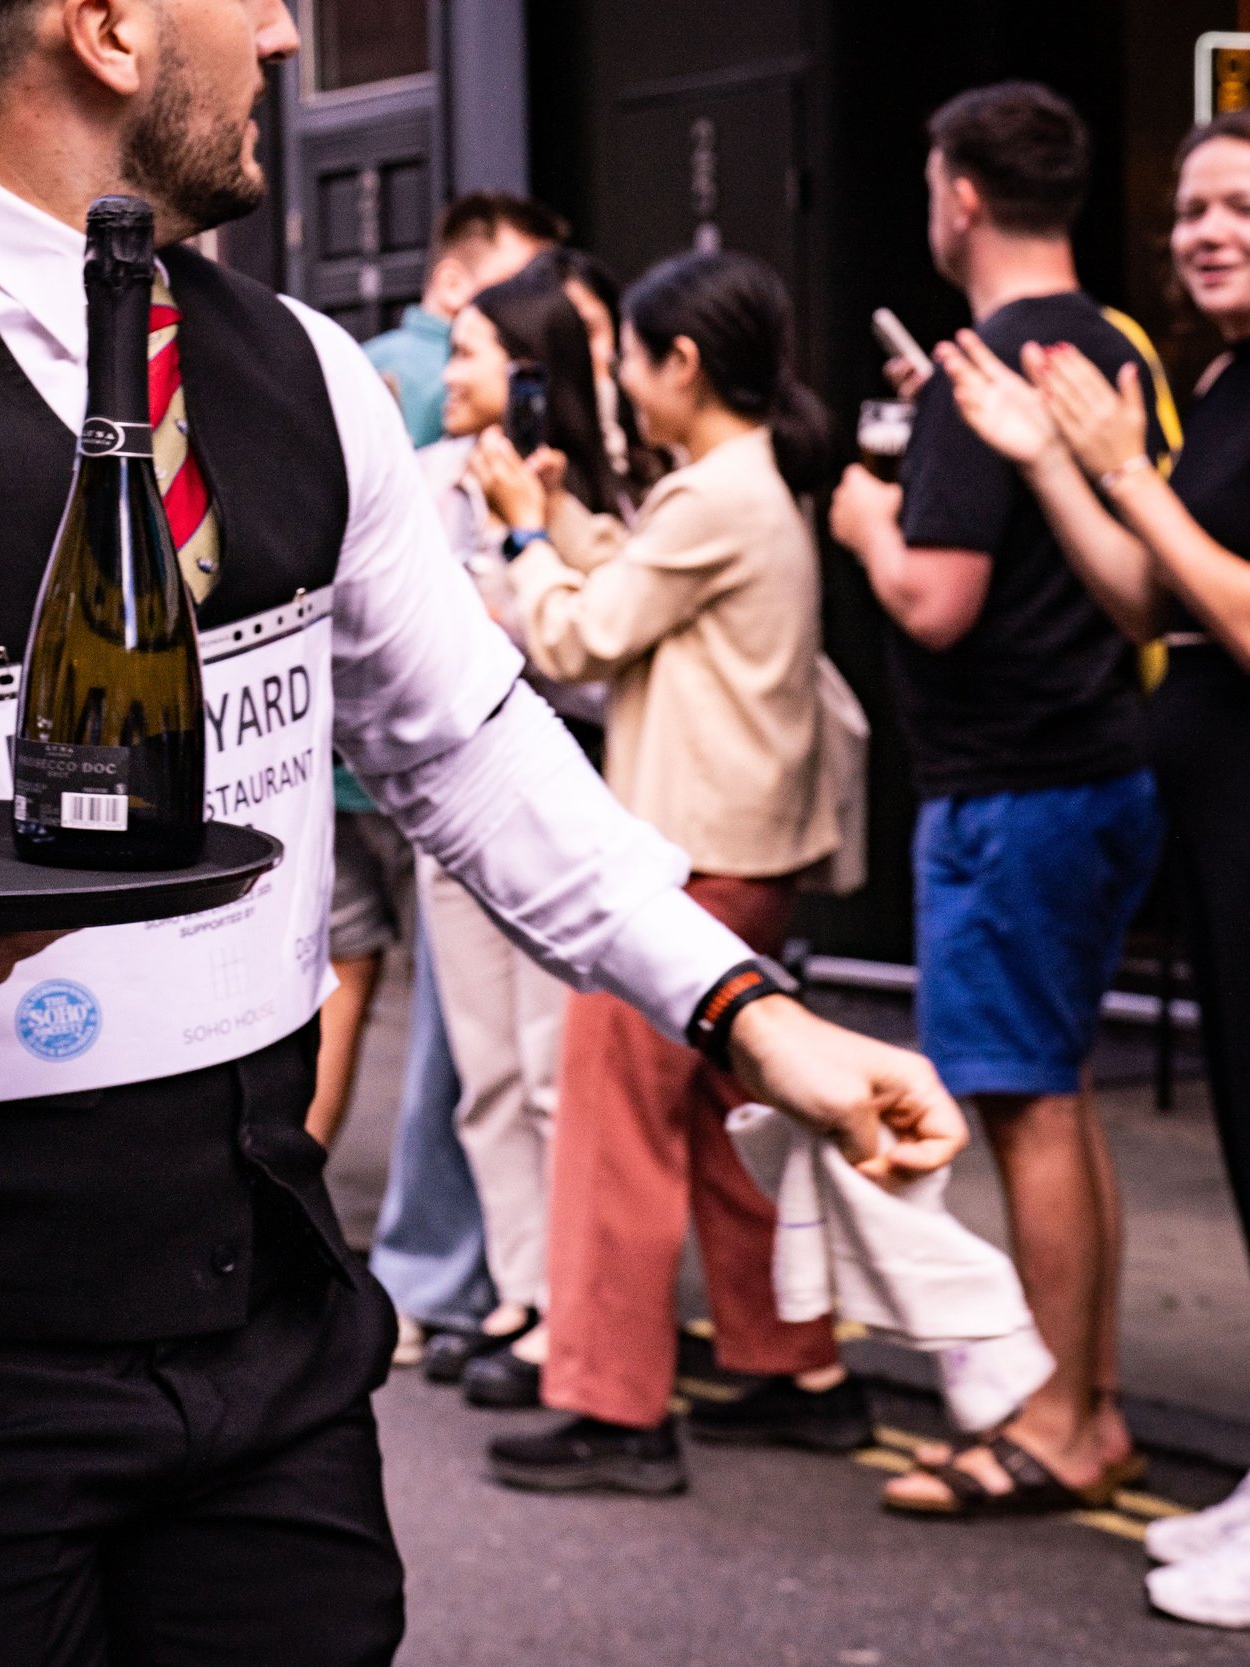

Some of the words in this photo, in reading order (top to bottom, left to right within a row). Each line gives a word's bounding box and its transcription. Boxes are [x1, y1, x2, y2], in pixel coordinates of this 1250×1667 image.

[82, 762, 117, 774] DOC
[207, 748, 314, 822] STAURANT
[180, 911, 242, 938] SUPPORTED
[30, 1003, 89, 1028] SOHO
[182, 1017, 231, 1045] SOHO
[234, 999, 276, 1028] HOUSE
